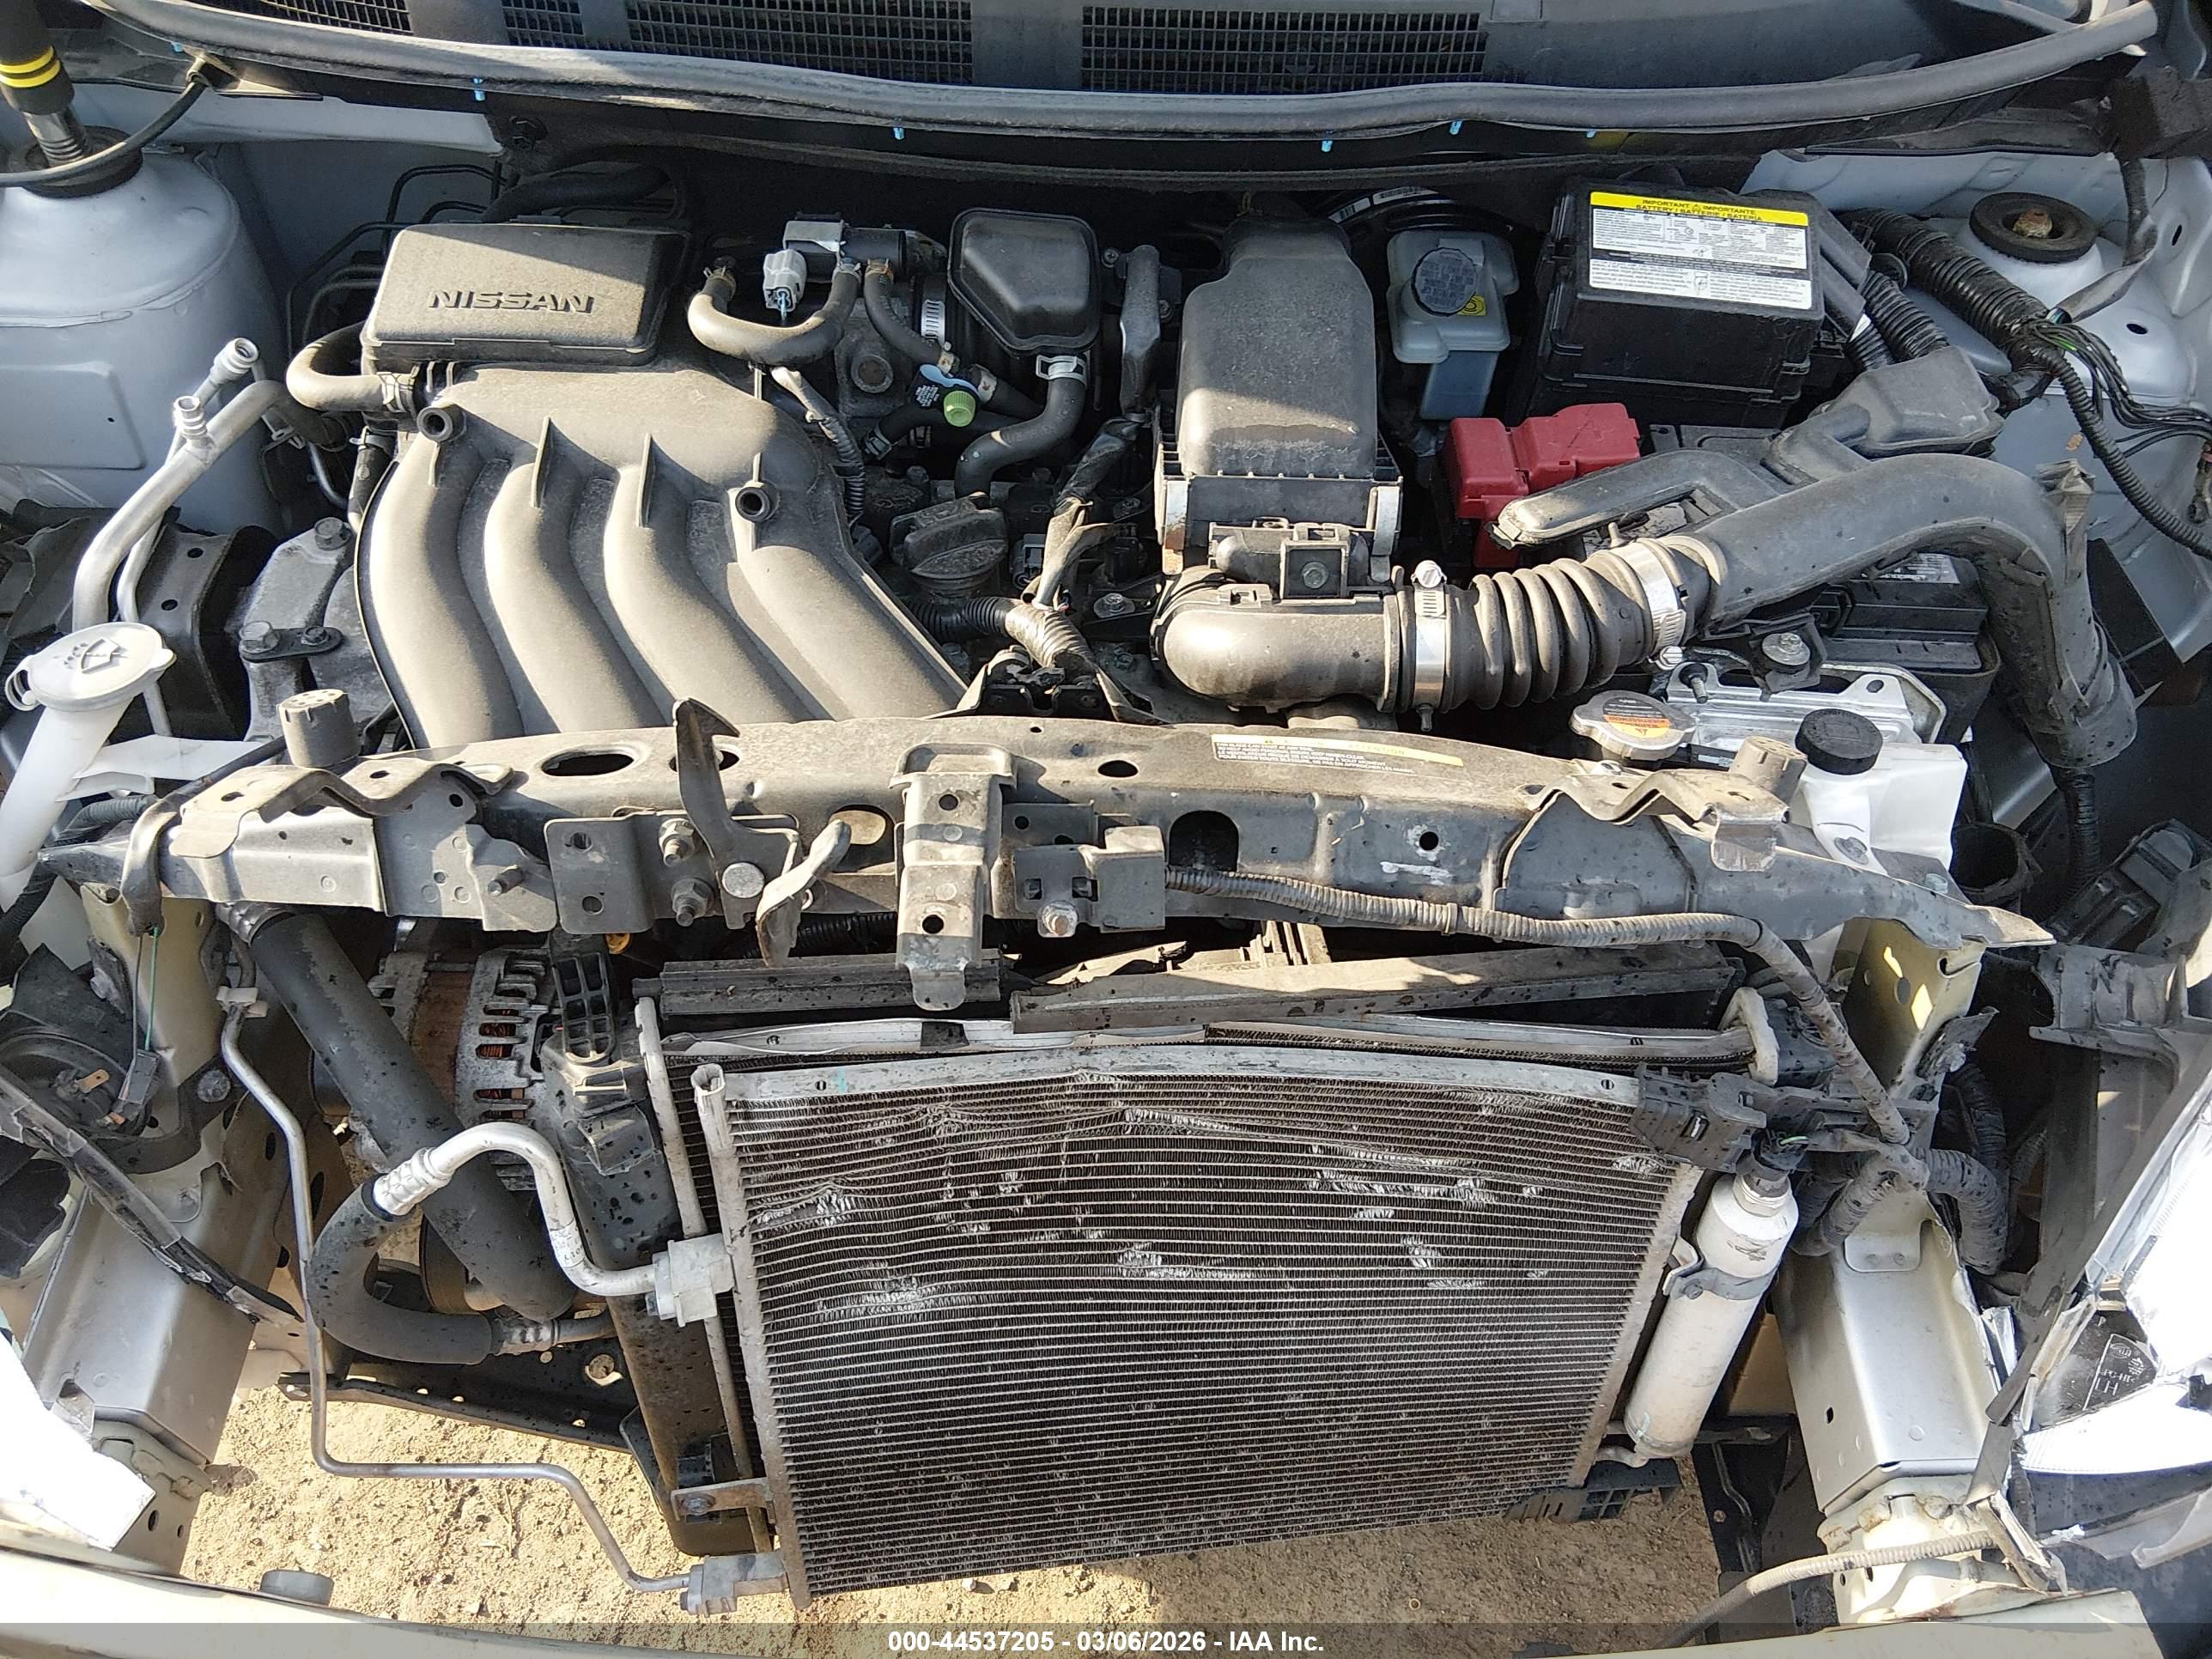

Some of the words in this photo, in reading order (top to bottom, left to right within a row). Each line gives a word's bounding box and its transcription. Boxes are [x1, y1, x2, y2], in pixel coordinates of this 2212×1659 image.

[1643, 199, 1690, 208] IMPORTANT
[1703, 205, 1756, 215] IMPORTANTE
[1680, 208, 1720, 216] BATTERIE
[428, 289, 595, 314] NISSAN
